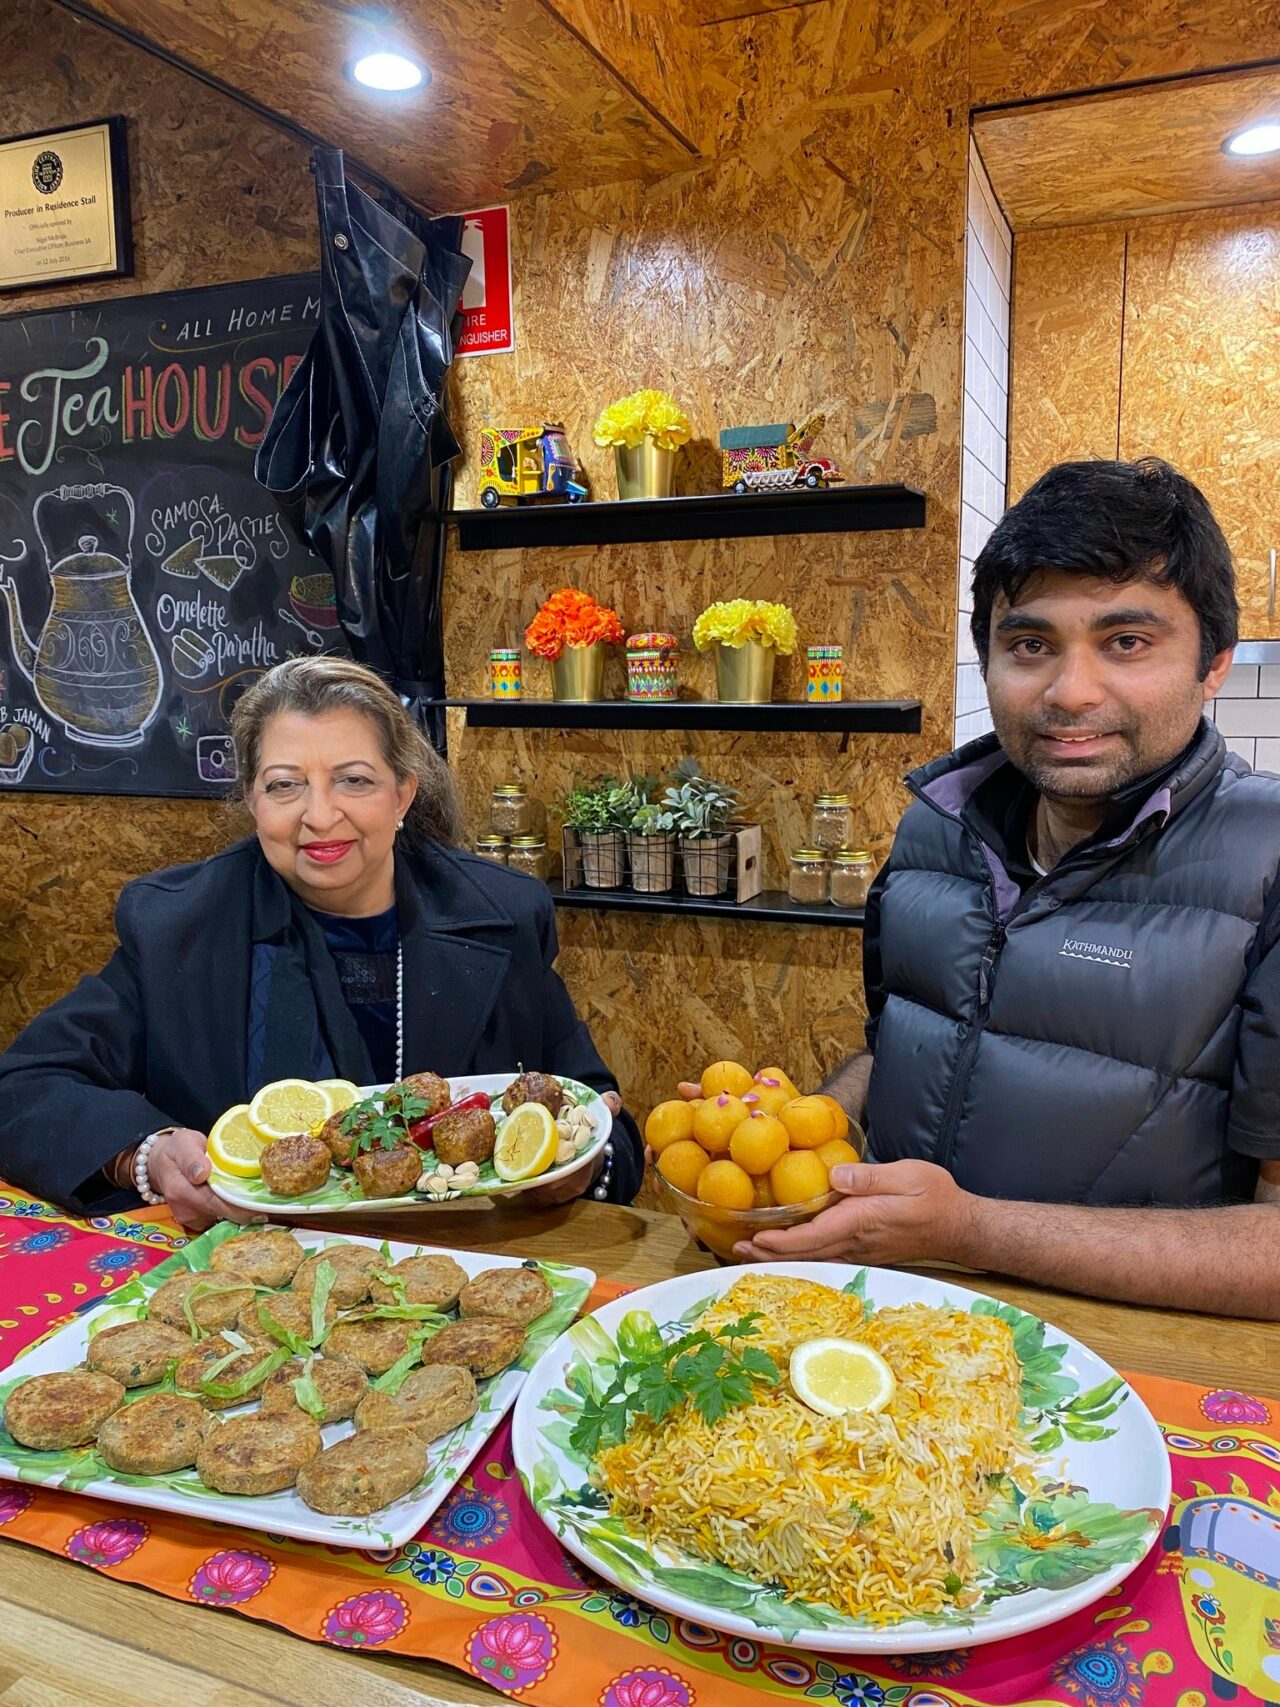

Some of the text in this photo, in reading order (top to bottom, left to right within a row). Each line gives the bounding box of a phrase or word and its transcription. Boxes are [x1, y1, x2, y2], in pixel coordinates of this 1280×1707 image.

[4, 195, 96, 218] Producer in Residence Stall
[176, 319, 213, 342] ALL
[227, 304, 294, 332] HOME
[459, 329, 508, 346] NGUISHER
[466, 313, 487, 328] IRE
[17, 336, 119, 475] Tea
[214, 512, 289, 570] PASTIES
[157, 589, 230, 632] Omelette
[13, 707, 51, 743] JAMAN
[1063, 939, 1134, 960] KATHMANDU
